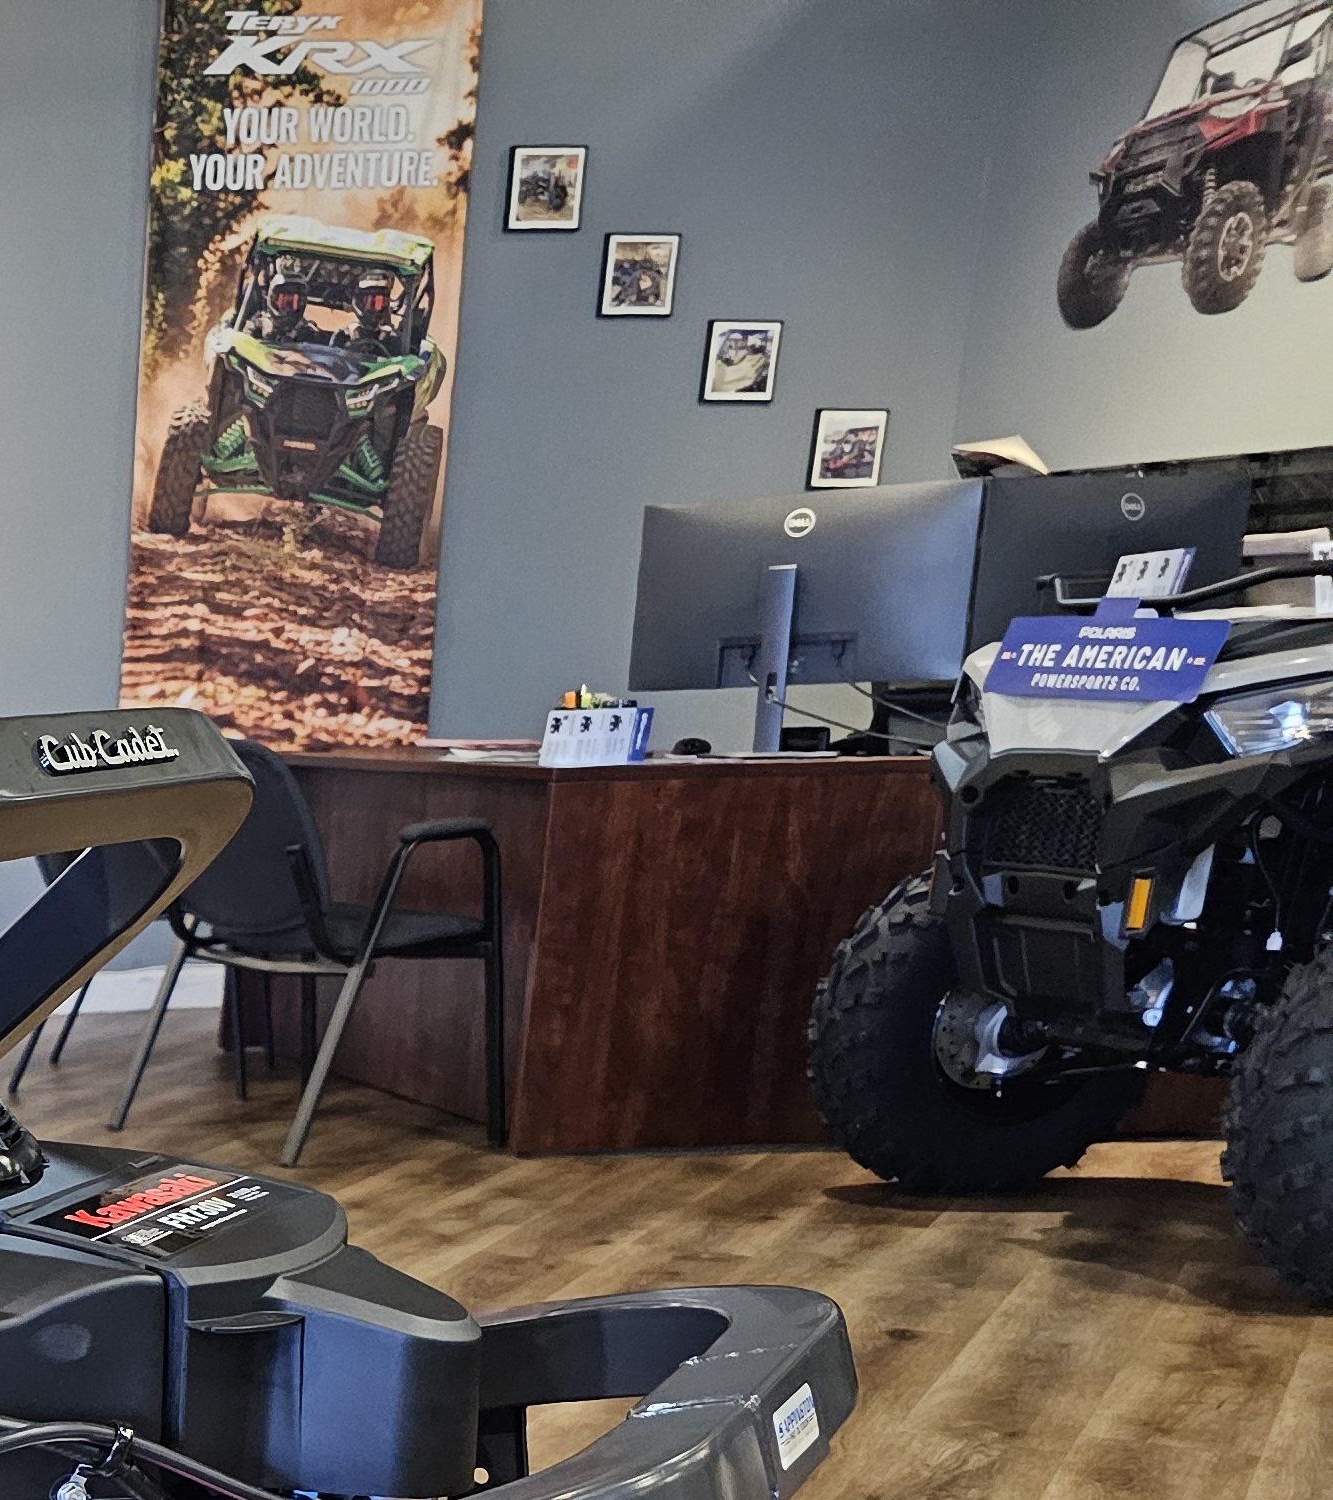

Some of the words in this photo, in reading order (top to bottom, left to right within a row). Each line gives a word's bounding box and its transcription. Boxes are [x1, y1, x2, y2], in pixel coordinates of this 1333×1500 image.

[203, 35, 434, 75] KRX
[350, 77, 432, 95] 1000
[223, 106, 299, 145] YOUR
[309, 105, 415, 144] WORLD.
[189, 153, 266, 191] YOUR
[273, 150, 439, 190] ADVENTURE.
[1077, 626, 1137, 640] POLARIS
[1016, 643, 1062, 667] THE
[1061, 644, 1188, 672] AMERICAN
[1030, 672, 1119, 691] POWERSPORTS
[1120, 676, 1141, 692] CO.
[39, 732, 98, 770] Cub
[91, 724, 179, 764] Cadet
[63, 1172, 218, 1229] Kawasaki
